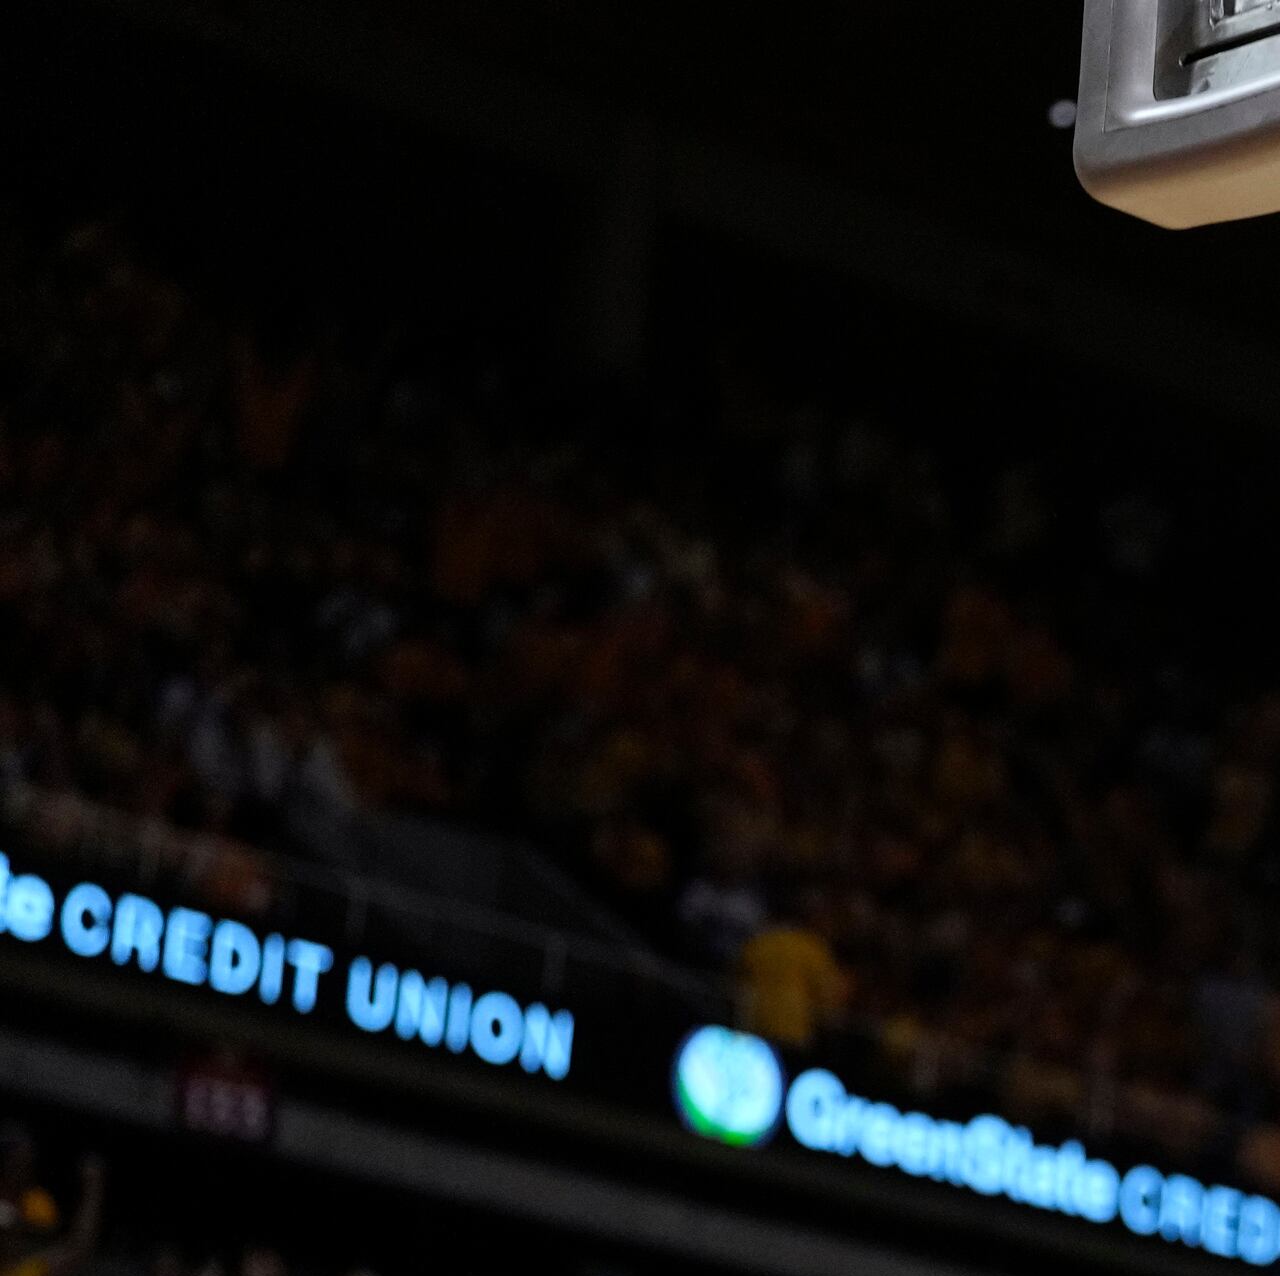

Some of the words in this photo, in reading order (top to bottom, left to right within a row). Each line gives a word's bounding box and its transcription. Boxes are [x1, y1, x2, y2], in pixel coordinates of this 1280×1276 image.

[61, 882, 334, 1014] CREDIT
[346, 955, 575, 1081] UNION
[786, 1067, 1121, 1224] GreenState
